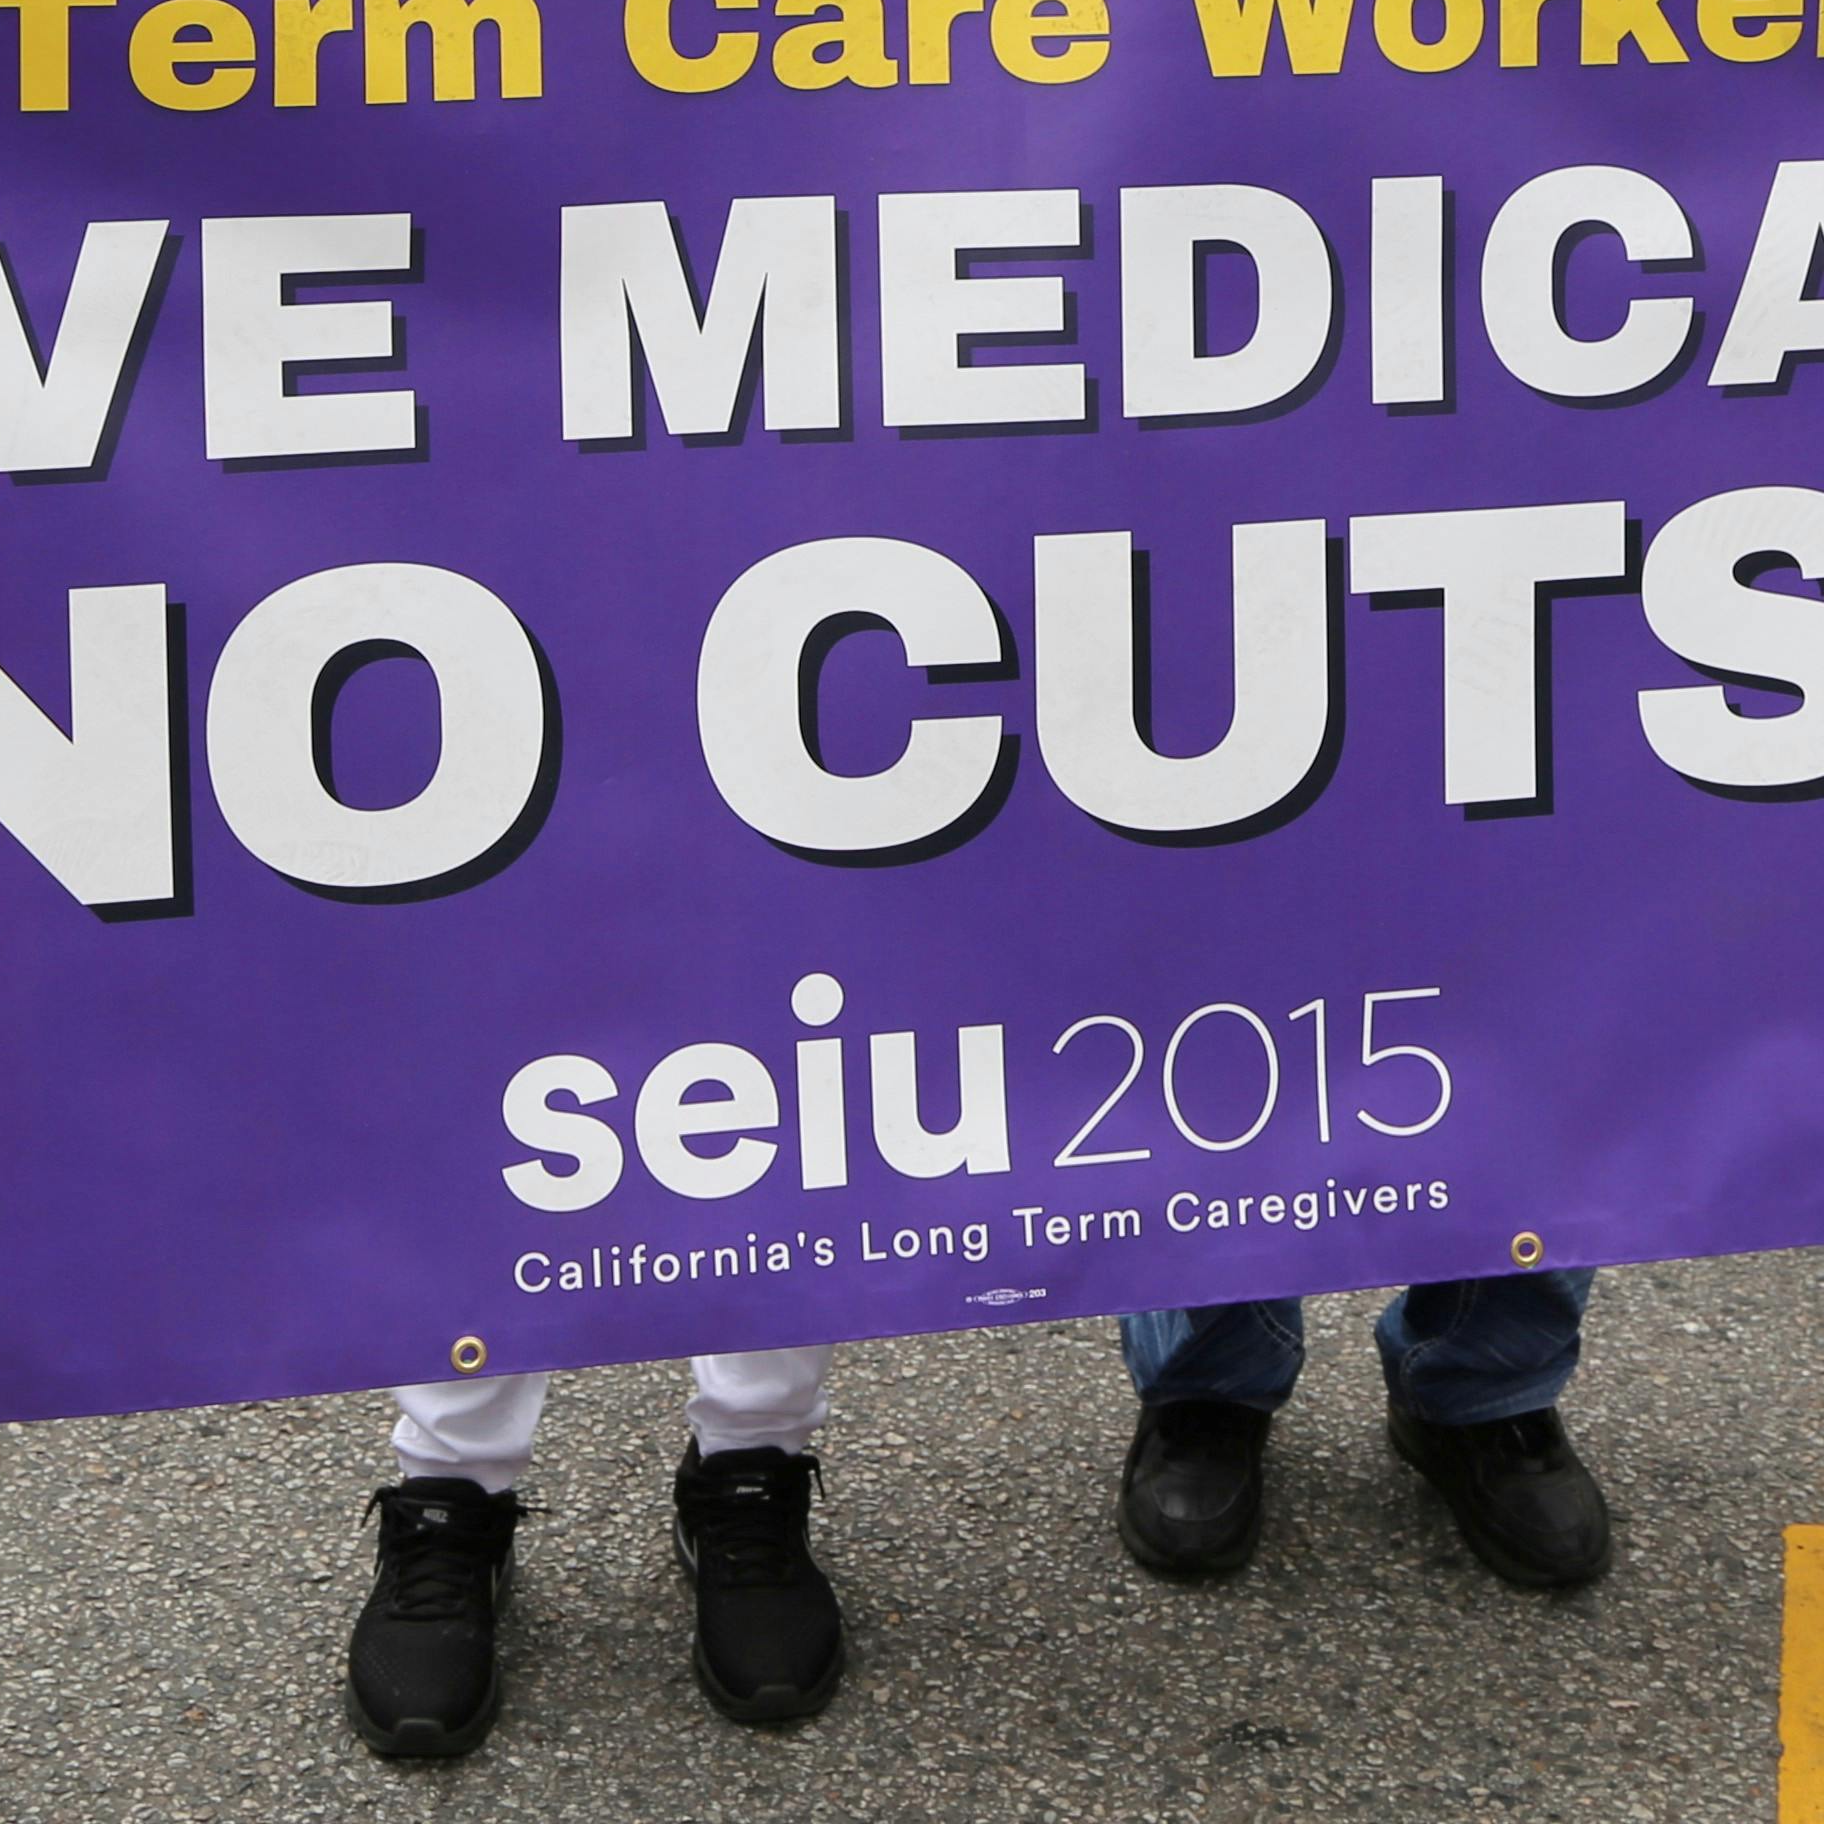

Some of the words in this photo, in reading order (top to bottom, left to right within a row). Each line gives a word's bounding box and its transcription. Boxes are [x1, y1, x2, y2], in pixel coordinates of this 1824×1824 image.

[501, 973, 1011, 1213] seiu
[1052, 987, 1453, 1169] 2015
[513, 1229, 836, 1295] California's
[862, 1212, 990, 1262] Long
[1013, 1204, 1142, 1249] Term
[1165, 1177, 1451, 1236] Caregivers
[1029, 1288, 1047, 1298] 203
